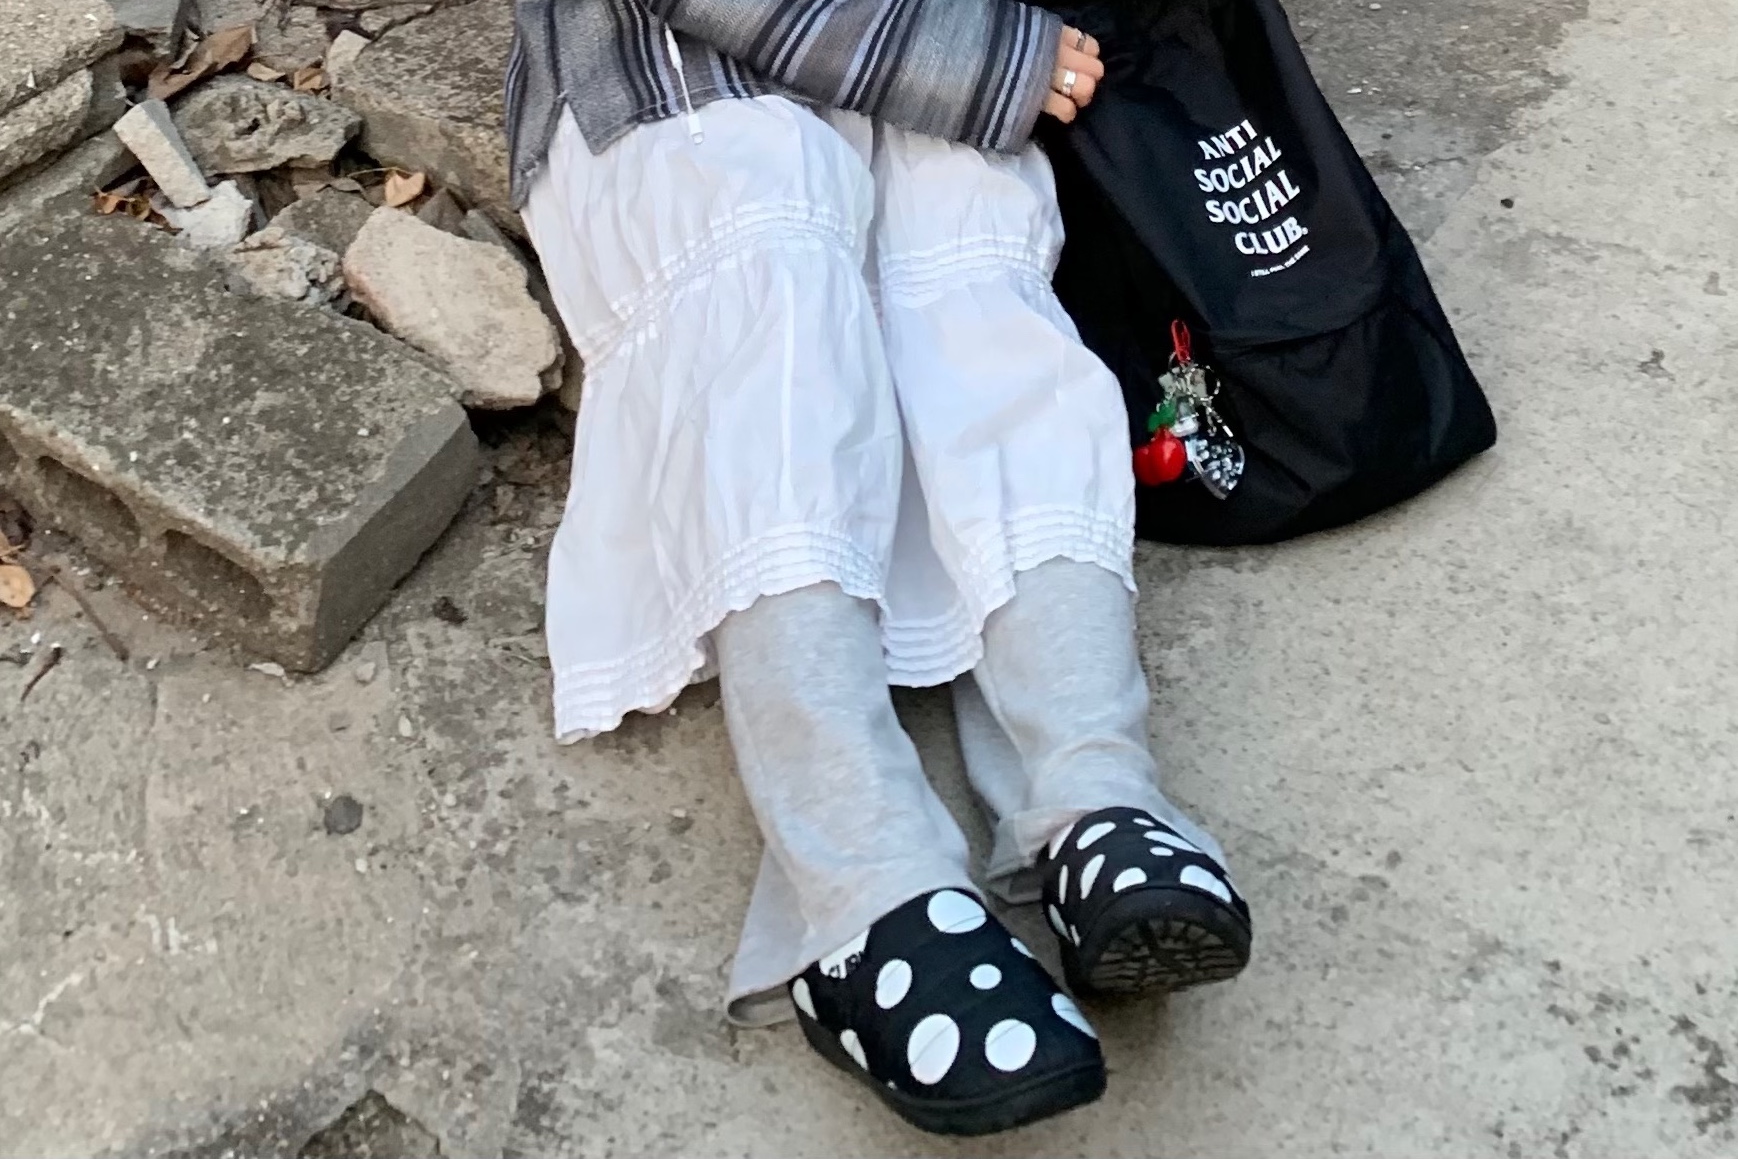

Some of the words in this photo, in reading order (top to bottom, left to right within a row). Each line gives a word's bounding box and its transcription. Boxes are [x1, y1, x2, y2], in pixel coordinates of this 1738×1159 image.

[1198, 119, 1258, 160] ANTI
[1193, 136, 1282, 193] SOCIAL
[1205, 169, 1301, 225] SOCIAL
[1234, 216, 1309, 255] CLUB.
